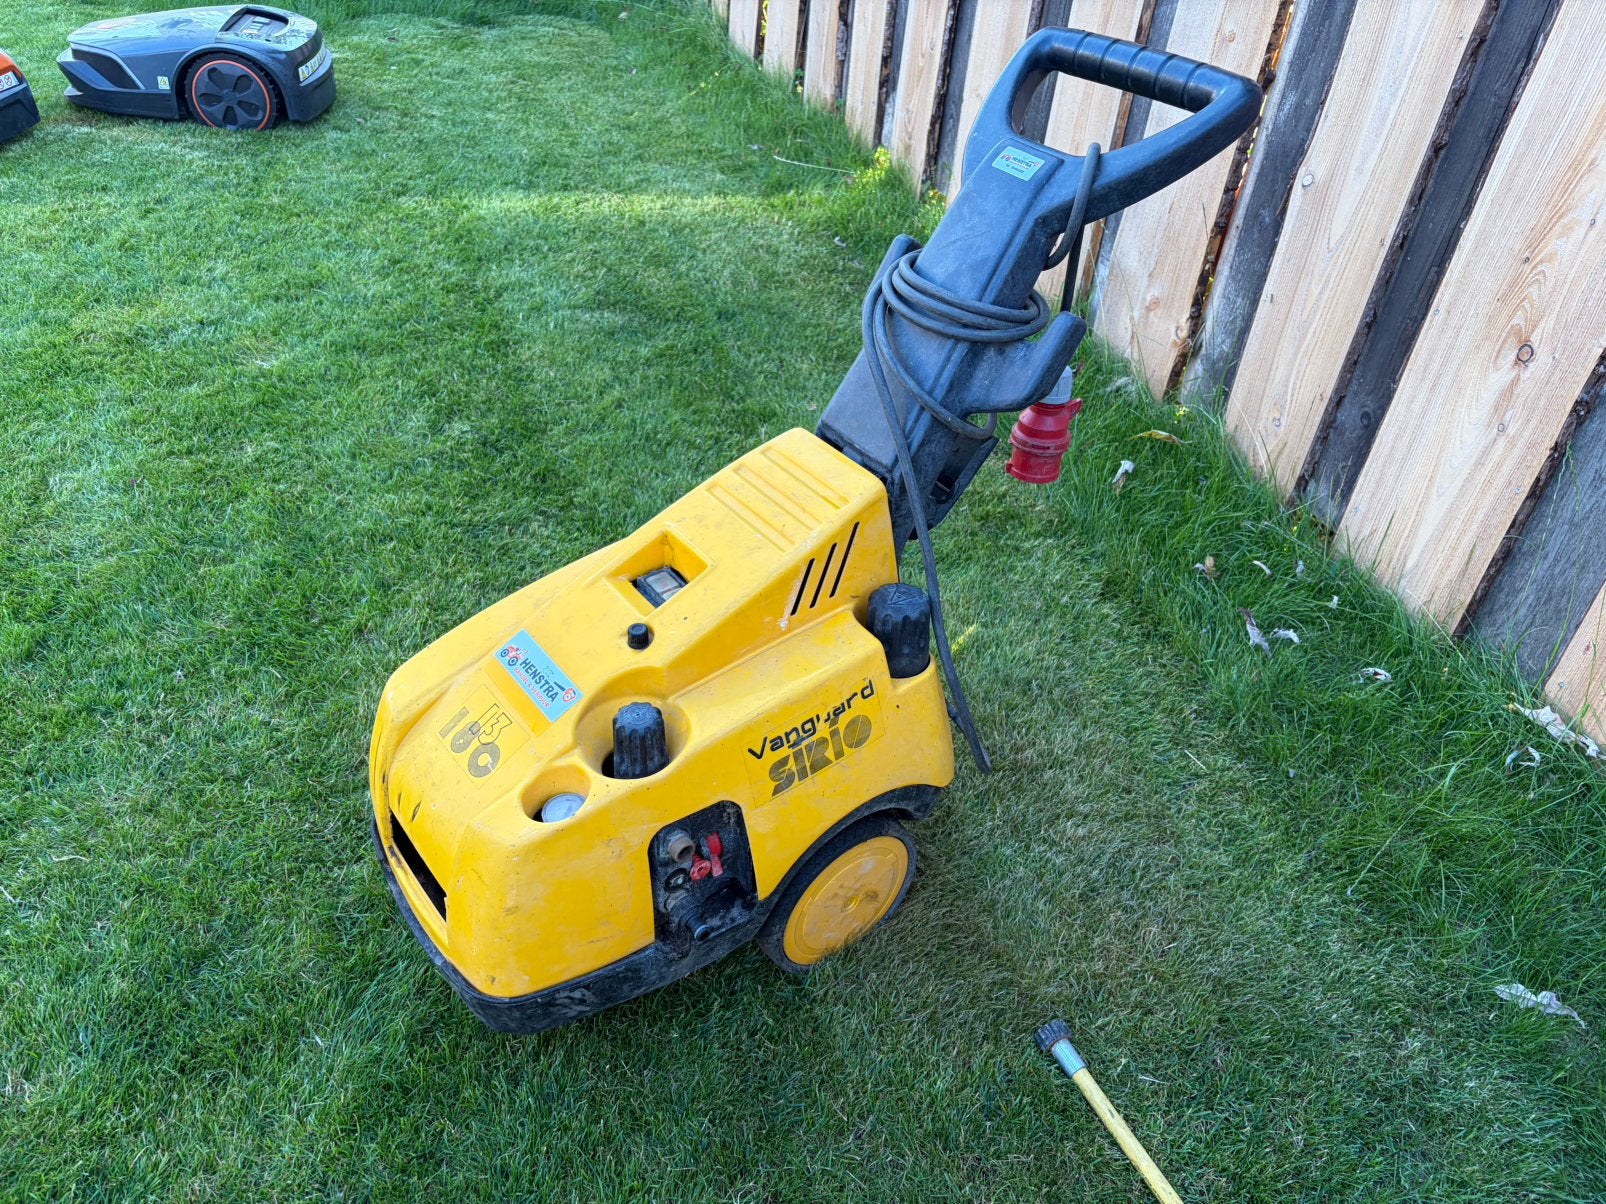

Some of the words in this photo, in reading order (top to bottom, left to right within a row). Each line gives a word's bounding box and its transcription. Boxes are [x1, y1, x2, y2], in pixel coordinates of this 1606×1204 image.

[513, 667, 529, 684] HANDEL
[531, 686, 550, 709] VERHUUR
[519, 657, 559, 703] HENSTRA
